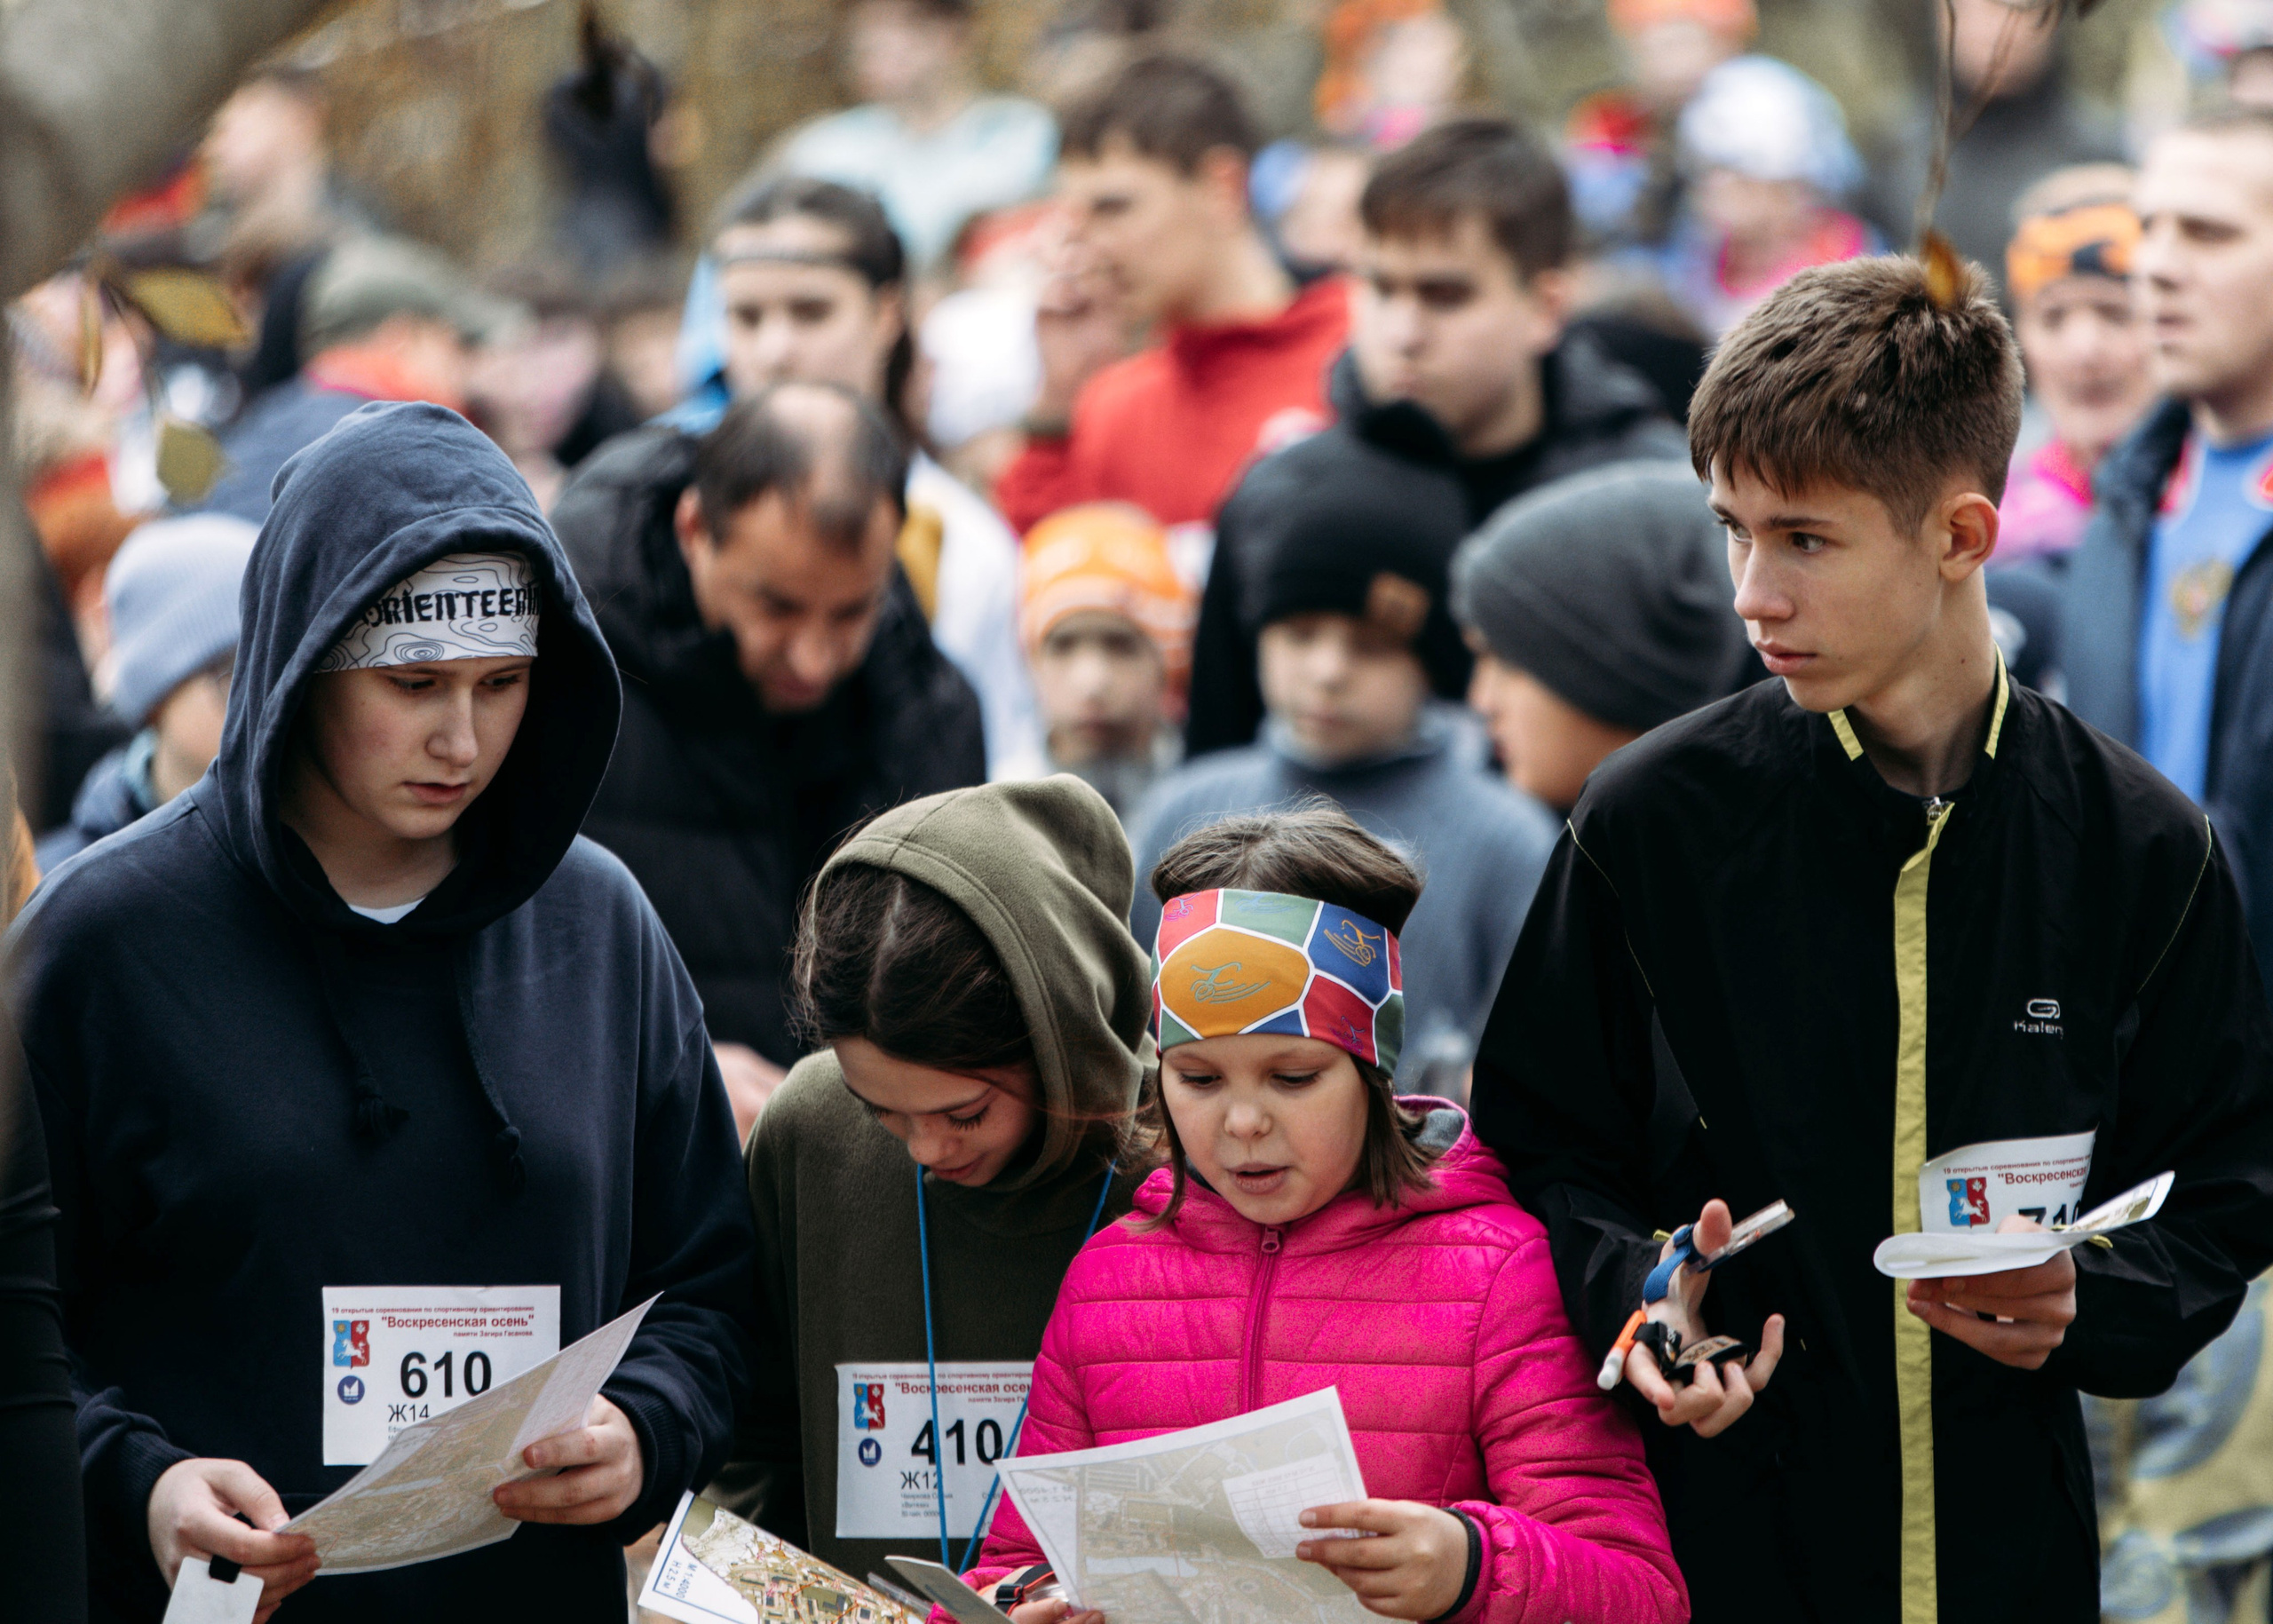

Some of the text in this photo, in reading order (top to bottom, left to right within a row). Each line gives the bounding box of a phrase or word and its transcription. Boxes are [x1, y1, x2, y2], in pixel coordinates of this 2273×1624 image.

[1998, 1167, 2087, 1185] "Воскресенска
[382, 1314, 535, 1330] "Воскресенская осень"
[400, 1351, 492, 1398] 610
[388, 1404, 430, 1422] Ж14
[911, 1419, 1003, 1466] 410
